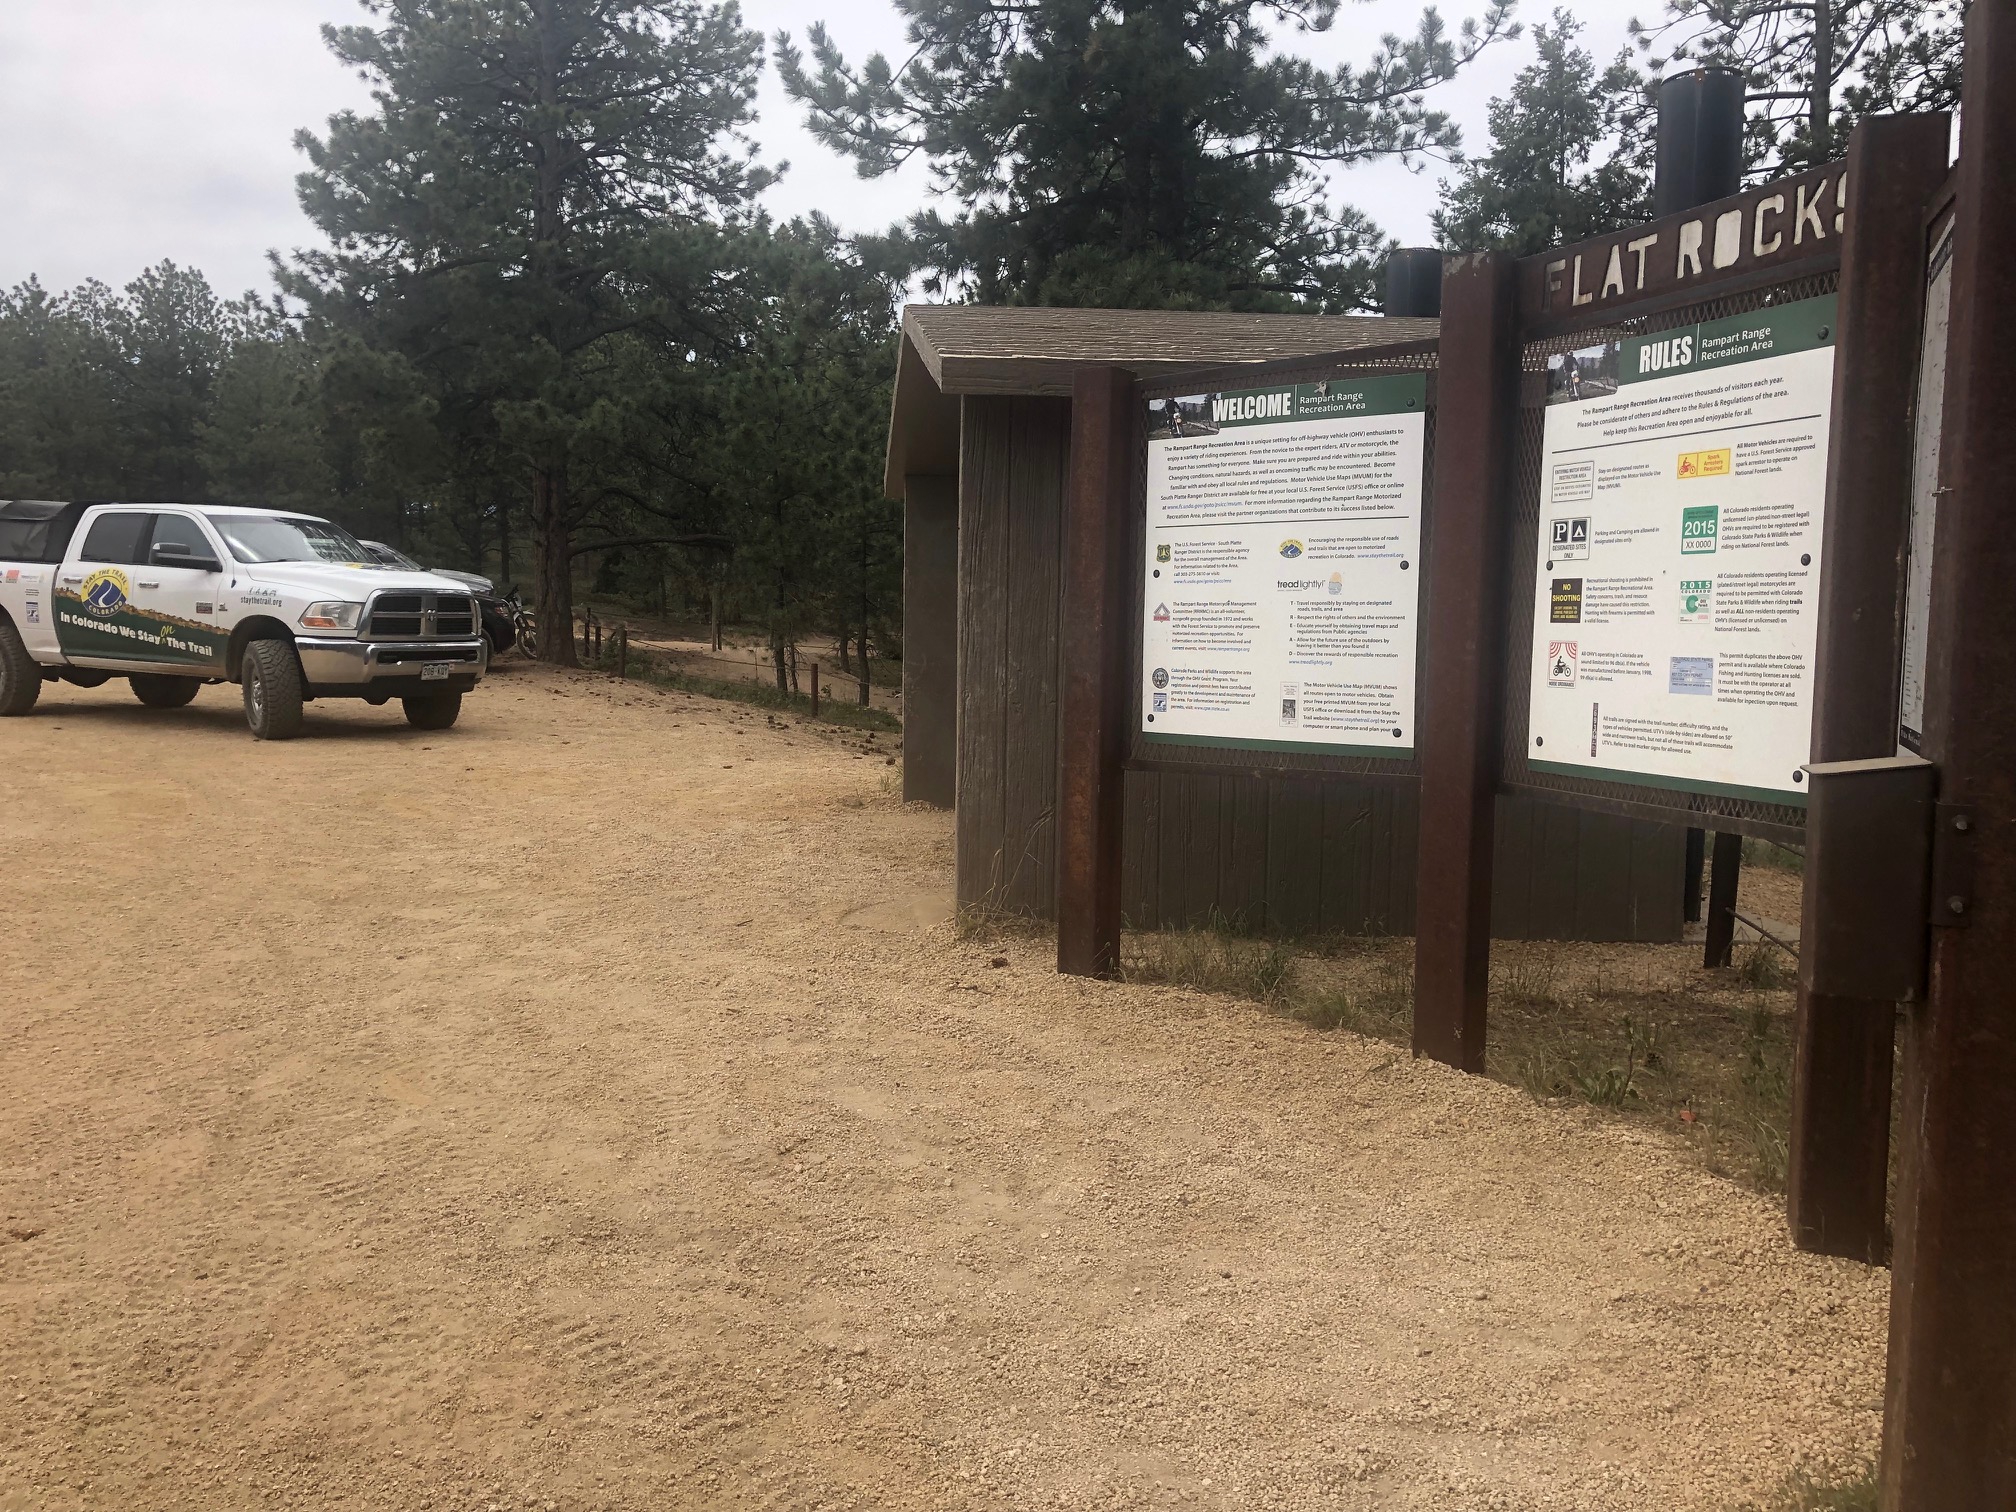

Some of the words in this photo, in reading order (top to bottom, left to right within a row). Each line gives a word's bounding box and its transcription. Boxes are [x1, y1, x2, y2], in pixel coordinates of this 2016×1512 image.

[1543, 234, 1658, 312] FLAT
[1702, 331, 1739, 349] Rampart
[1742, 326, 1771, 343] Range
[1639, 335, 1692, 373] RULES
[1701, 345, 1748, 361] Recreation
[1751, 340, 1773, 353] Area
[1300, 395, 1335, 406] Rampart
[1337, 391, 1363, 402] Range
[1592, 406, 1613, 414] Rampart
[1630, 399, 1658, 407] Recreation
[1694, 387, 1724, 396] thousands
[1724, 384, 1731, 392] of
[1732, 382, 1753, 390] visitors
[1754, 378, 1768, 387] each
[1212, 392, 1291, 422] WELCOME
[1299, 403, 1343, 414] Recreation
[1346, 402, 1366, 411] Area
[1600, 416, 1628, 424] considerate
[1651, 409, 1662, 417] and
[1720, 396, 1754, 406] Regulations
[1755, 392, 1762, 400] of
[1638, 423, 1666, 431] Recreation
[1694, 415, 1705, 423] and
[1706, 412, 1734, 421] enjoyable
[1555, 524, 1566, 541] P
[1684, 520, 1715, 535] 2015
[1696, 540, 1711, 548] 0000
[84, 574, 96, 589] STAY
[112, 570, 127, 585] TRAIL
[241, 597, 282, 607] staythetrail.org
[1553, 594, 1580, 602] SHOOTING
[89, 601, 122, 614] COLORADO
[61, 612, 70, 623] In
[72, 614, 118, 634] Colorado
[119, 625, 136, 638] We
[138, 629, 161, 645] Stay
[161, 625, 175, 637] on
[166, 637, 186, 650] The
[188, 642, 212, 656] Trail
